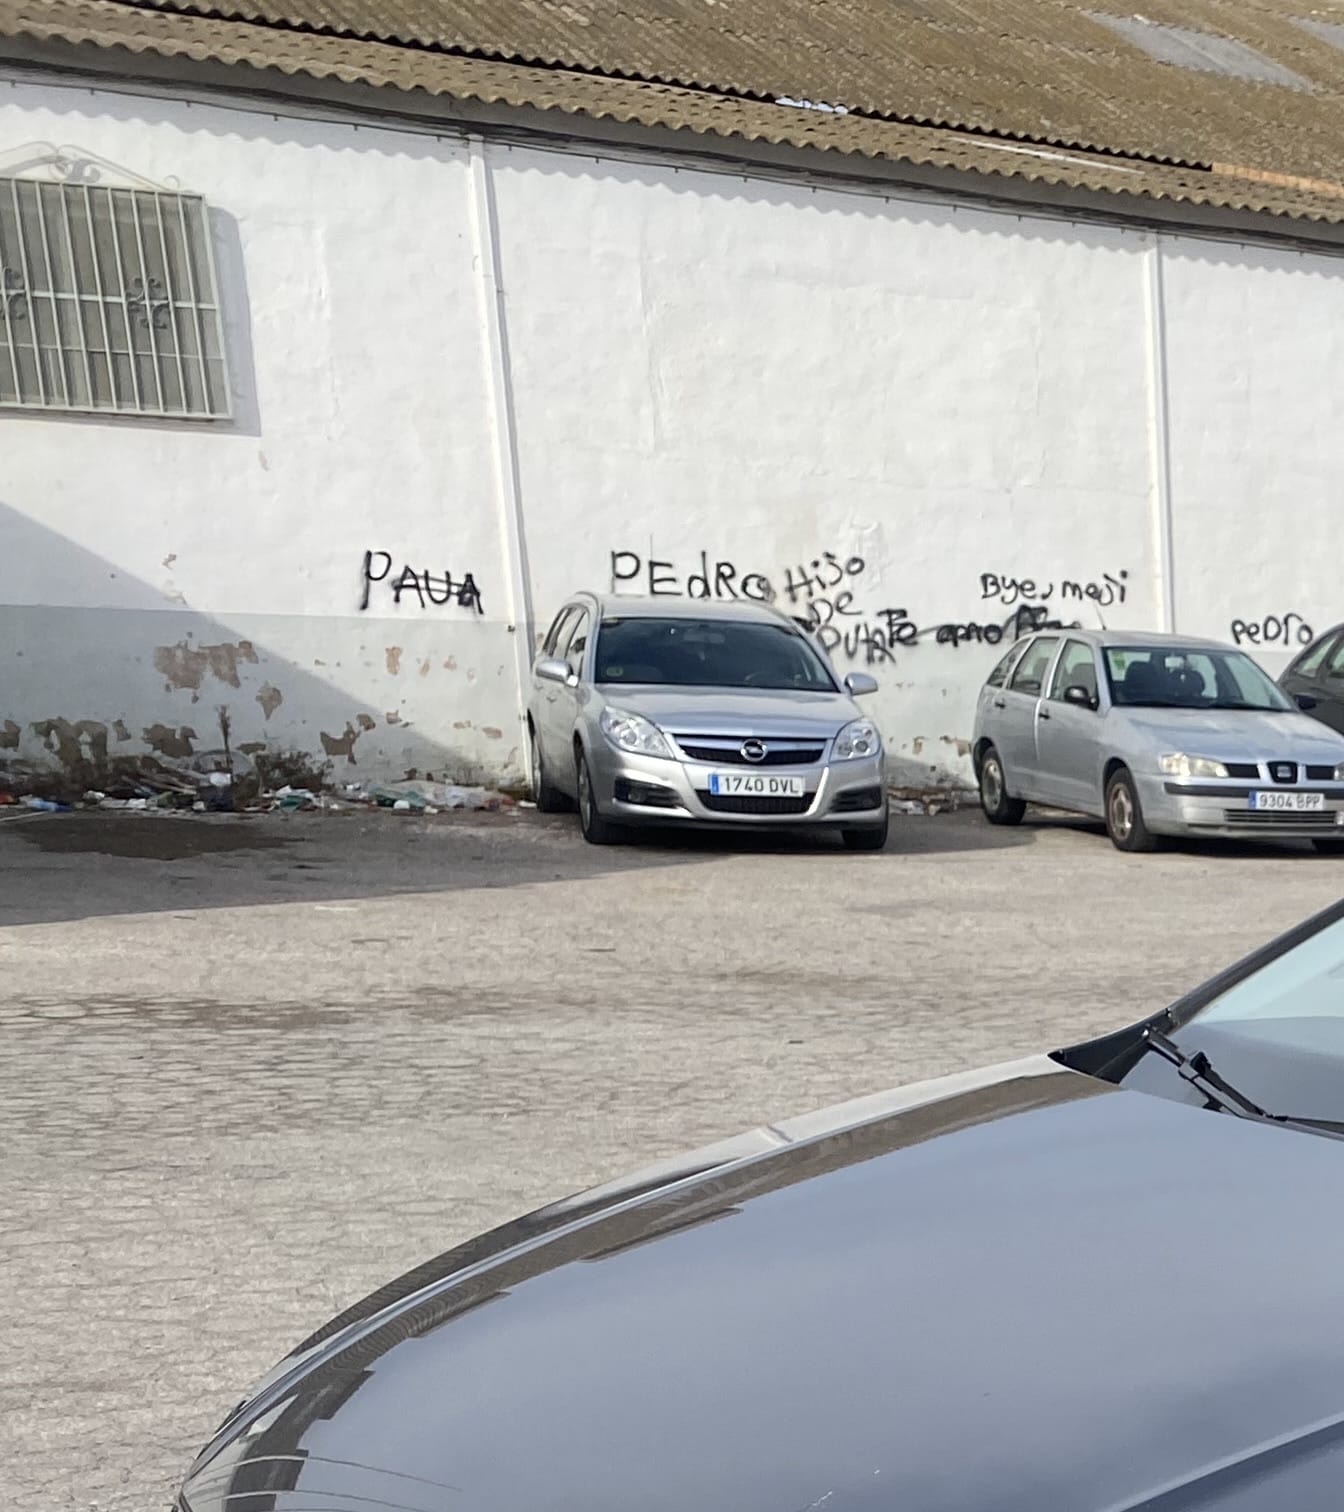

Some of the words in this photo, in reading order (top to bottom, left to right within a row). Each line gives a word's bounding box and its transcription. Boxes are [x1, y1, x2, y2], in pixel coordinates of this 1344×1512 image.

[725, 776, 765, 793] 1740
[769, 777, 800, 794] DVL
[1259, 793, 1293, 809] 9304
